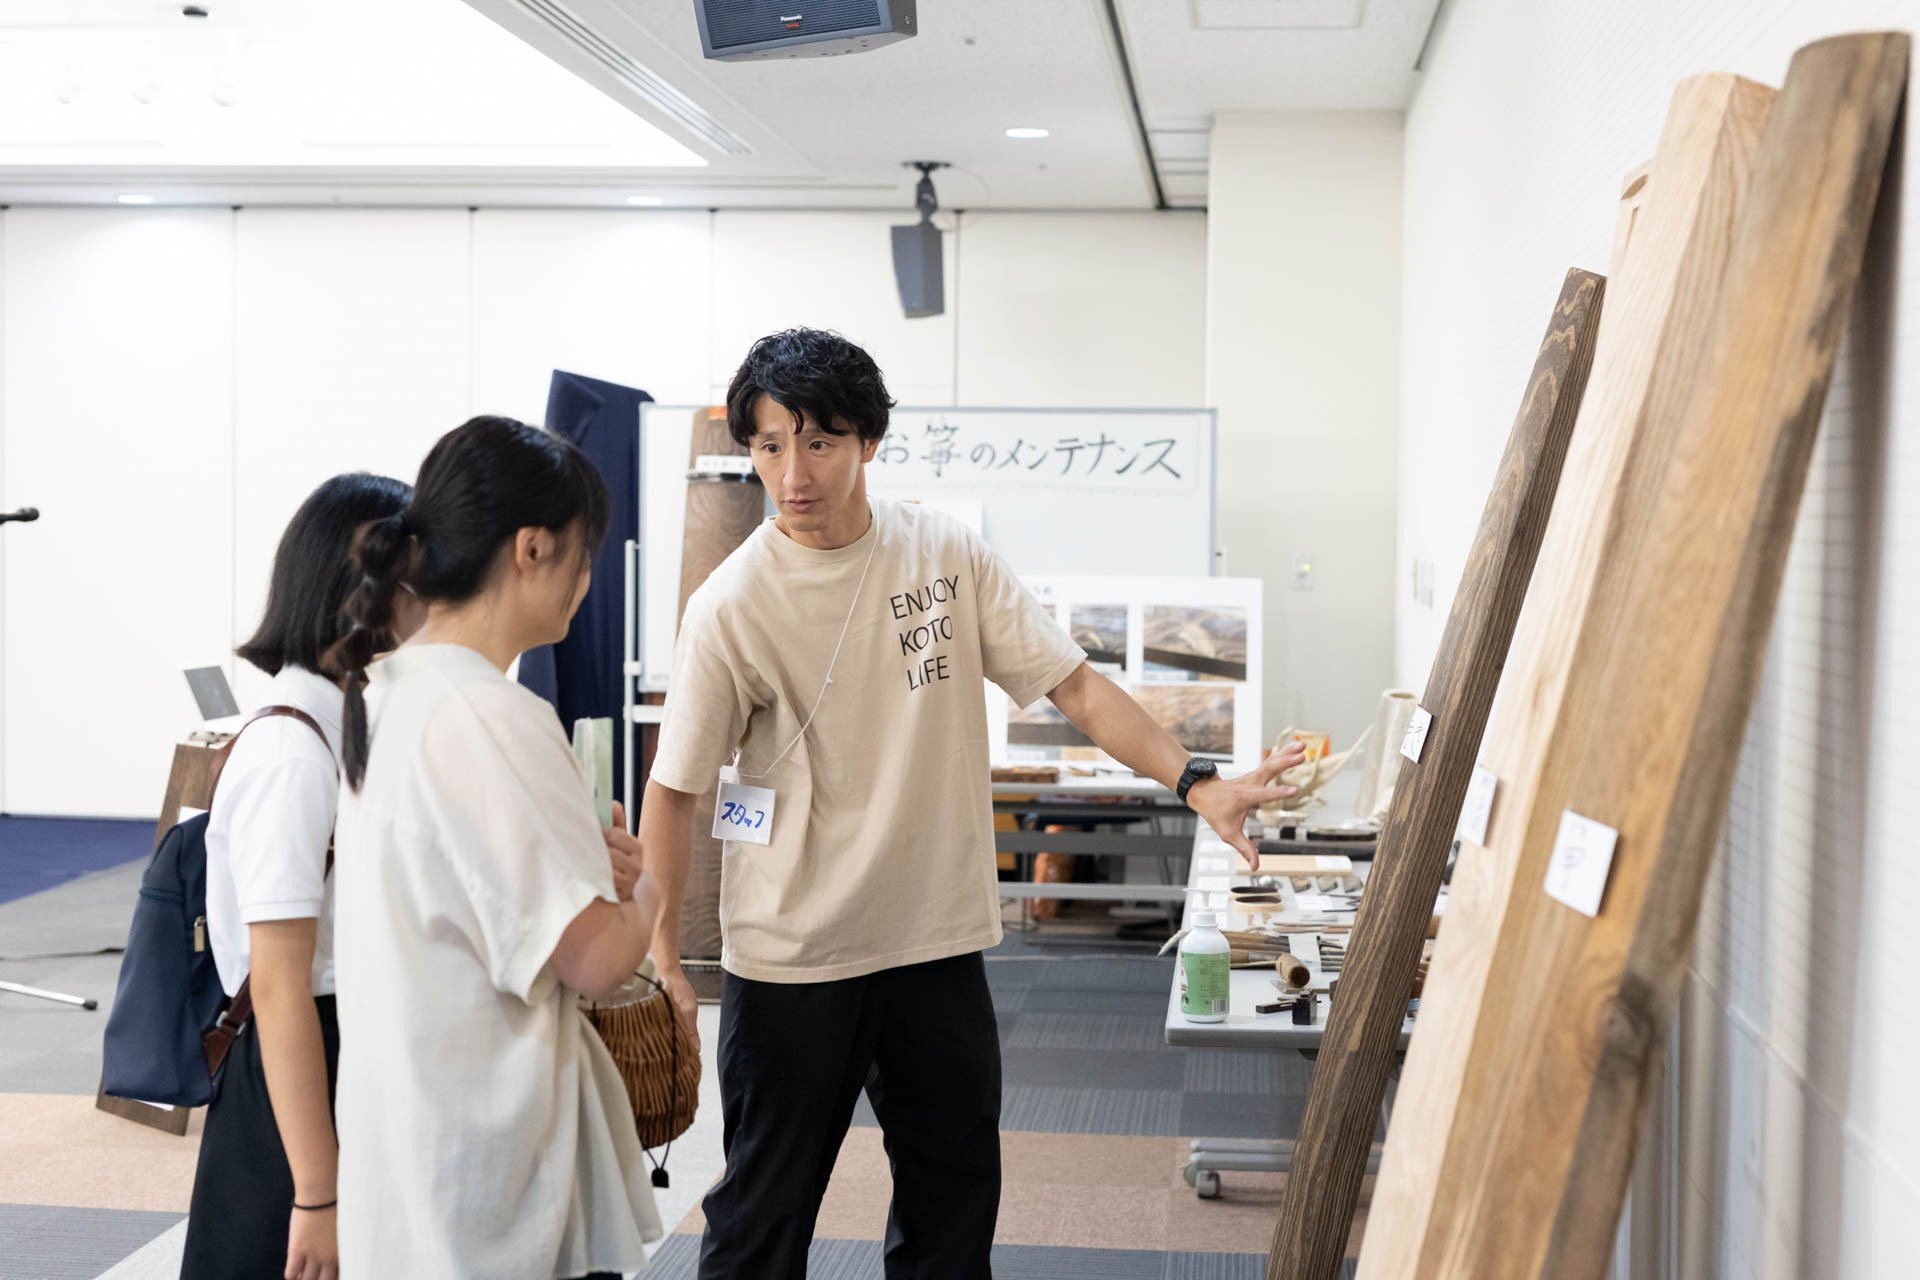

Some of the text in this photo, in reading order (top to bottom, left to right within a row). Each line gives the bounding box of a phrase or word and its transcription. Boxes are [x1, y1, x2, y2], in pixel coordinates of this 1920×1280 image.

[889, 575, 959, 620] ENJOY
[899, 615, 953, 656] KOTO
[907, 655, 950, 691] LIFE
[721, 801, 765, 829] スタッフ
